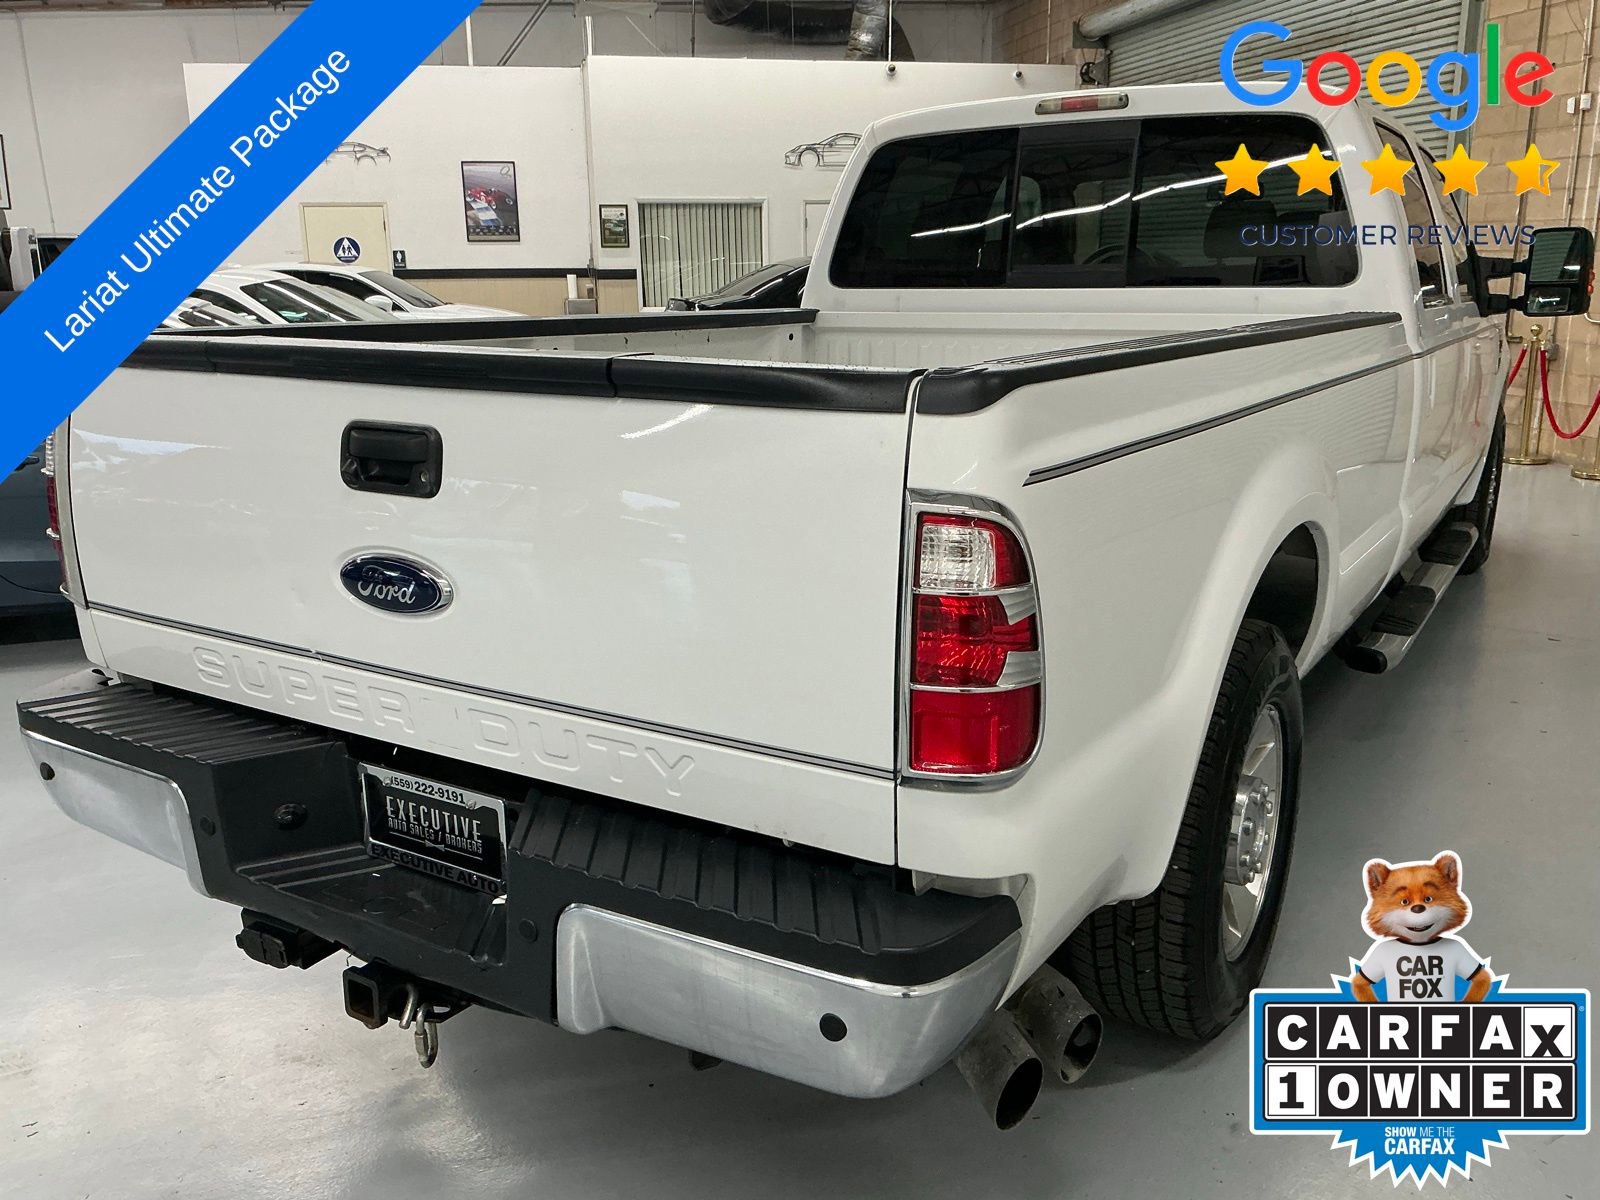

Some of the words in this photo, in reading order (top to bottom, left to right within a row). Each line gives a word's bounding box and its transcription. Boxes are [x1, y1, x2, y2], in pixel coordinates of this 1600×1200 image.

[357, 565, 416, 604] Ford
[192, 646, 416, 733] SUPER
[468, 708, 696, 797] DUTY
[386, 795, 483, 843] EXECUTIVE
[388, 817, 407, 833] AUTO
[409, 823, 435, 840] SALES
[445, 833, 483, 854] BROKERS
[371, 843, 455, 880] EXECUTIVE
[457, 871, 499, 894] AUTO
